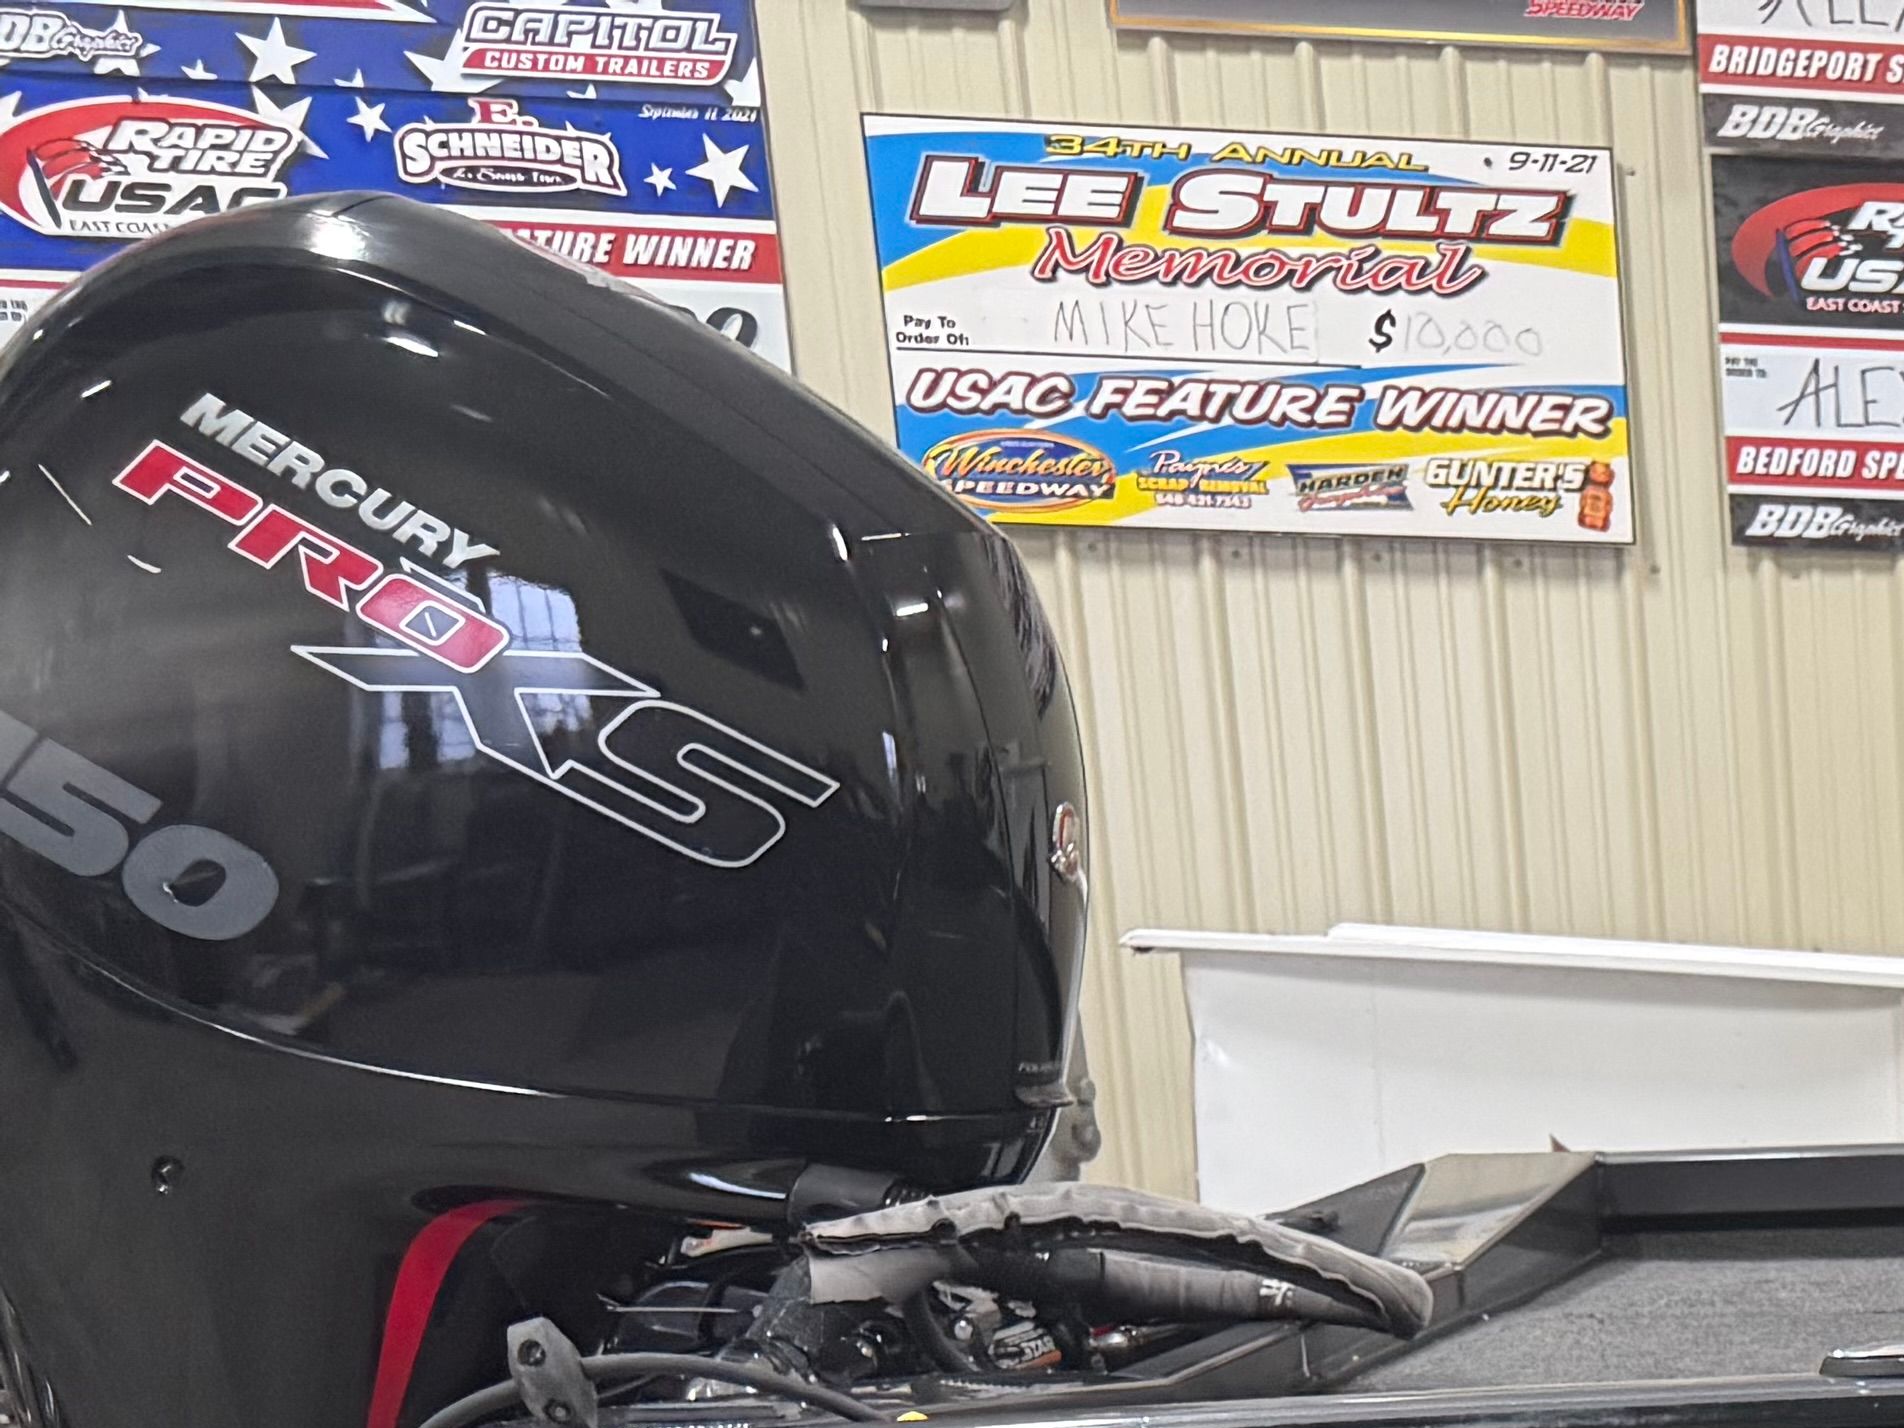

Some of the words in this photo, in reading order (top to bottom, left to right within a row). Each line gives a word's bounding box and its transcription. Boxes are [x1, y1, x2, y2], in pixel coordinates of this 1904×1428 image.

[467, 11, 730, 53] CAPITOL
[483, 51, 584, 72] CUSTOM
[596, 56, 710, 79] TRAILERS
[1709, 44, 1882, 82] BRIDGEPORT
[106, 121, 289, 153] RAPID
[1717, 104, 1819, 141] BDB
[154, 151, 272, 174] TIRE
[402, 130, 620, 186] SCHNEIDER
[1045, 134, 1193, 160] 34TH
[1210, 141, 1430, 172] ANNUAL
[1508, 150, 1598, 174] 9-11-21
[910, 154, 1145, 226] LEE
[1163, 167, 1574, 247] STULTZ
[622, 233, 756, 270] WINNER
[1030, 225, 1490, 298] Memorial
[903, 314, 933, 330] Pay
[937, 315, 957, 329] To
[1806, 296, 1844, 312] EAST
[1847, 299, 1900, 314] COAST
[895, 331, 940, 345] Order
[1053, 299, 1175, 352] MIKE
[1192, 299, 1310, 356] HOKE
[905, 367, 1077, 420] USAC
[1088, 374, 1365, 430] FEATURE
[1372, 384, 1616, 438] WINNER
[932, 445, 1112, 478] Winchester
[1424, 458, 1588, 493] GUNTER'S
[1736, 446, 1854, 478] BEDFORD
[180, 393, 500, 569] MERCURY
[1441, 485, 1562, 518] Honey
[1745, 503, 1844, 539] BDB
[113, 439, 510, 674] PRO
